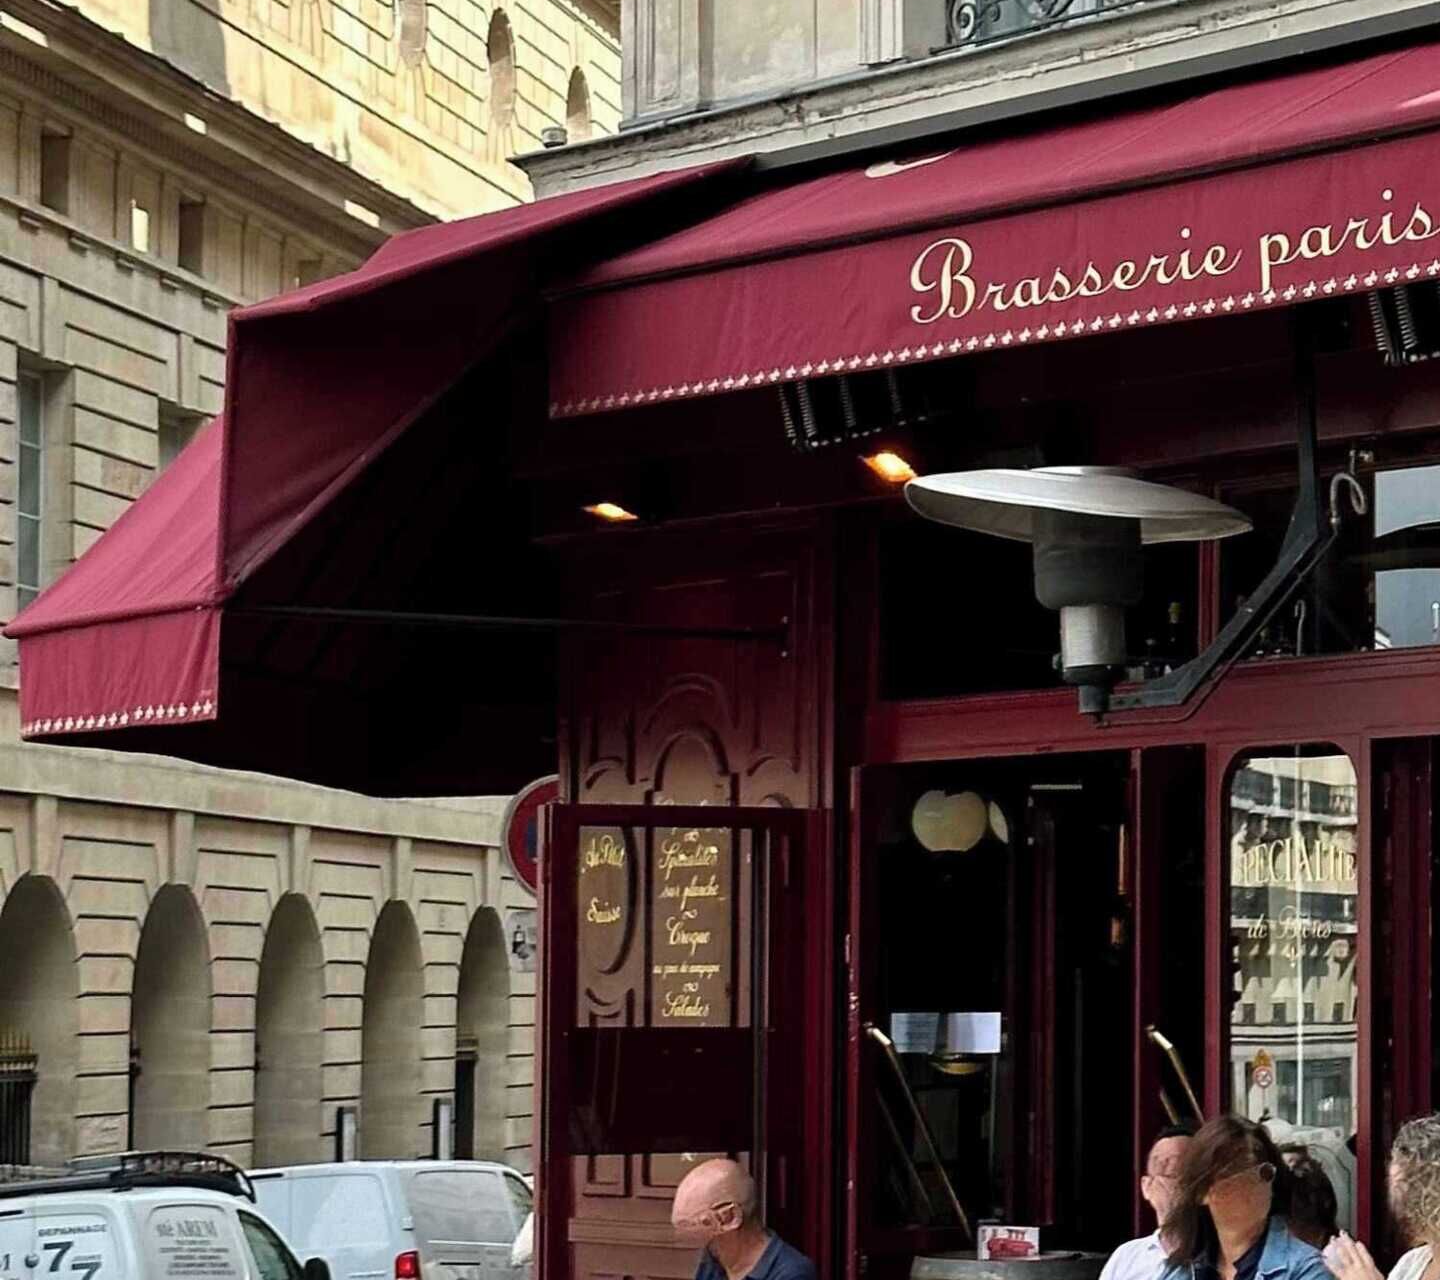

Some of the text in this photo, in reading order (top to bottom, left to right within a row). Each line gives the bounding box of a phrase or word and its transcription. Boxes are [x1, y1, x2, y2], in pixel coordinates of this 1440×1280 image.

[909, 227, 1243, 325] Brasserie
[1235, 835, 1356, 884] PECIALITE
[42, 1240, 74, 1273] 7
